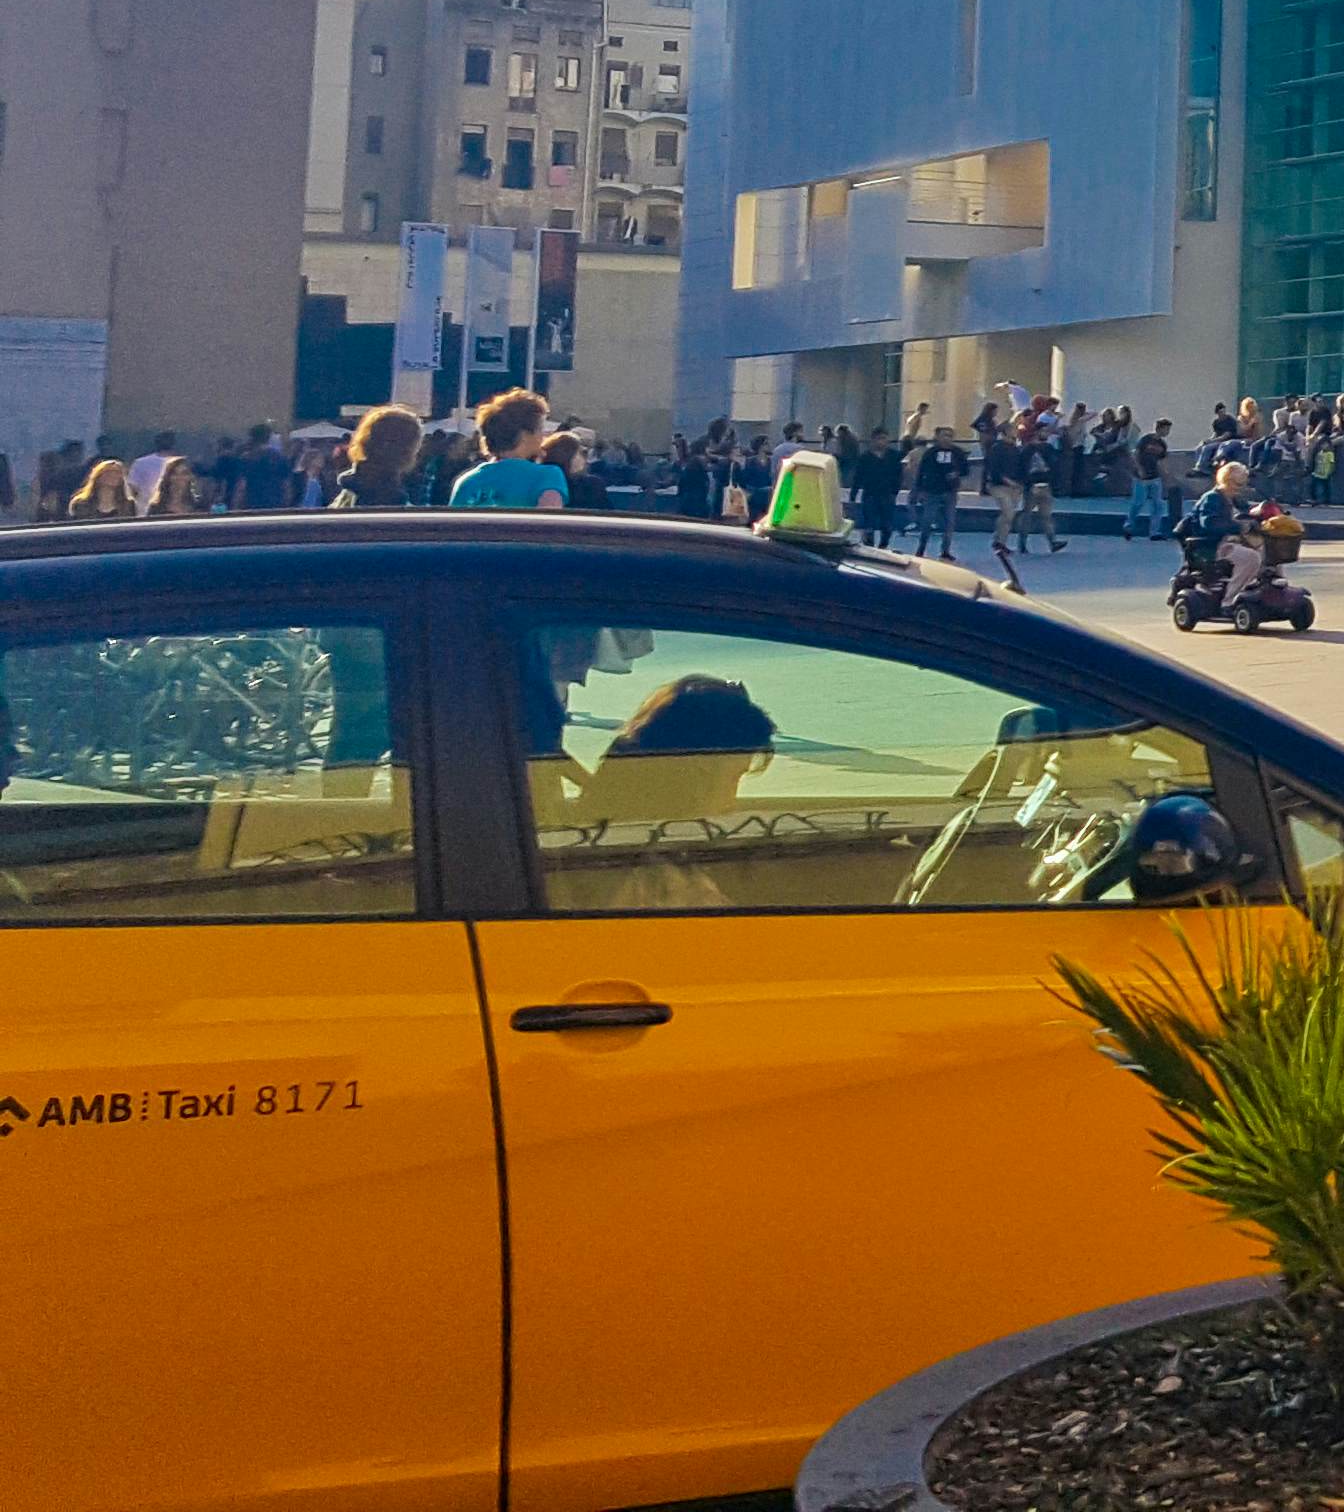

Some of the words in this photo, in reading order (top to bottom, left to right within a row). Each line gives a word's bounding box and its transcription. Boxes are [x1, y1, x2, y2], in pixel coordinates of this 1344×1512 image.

[37, 1092, 132, 1128] AMB
[157, 1085, 236, 1120] Taxi
[253, 1080, 364, 1116] 8171
